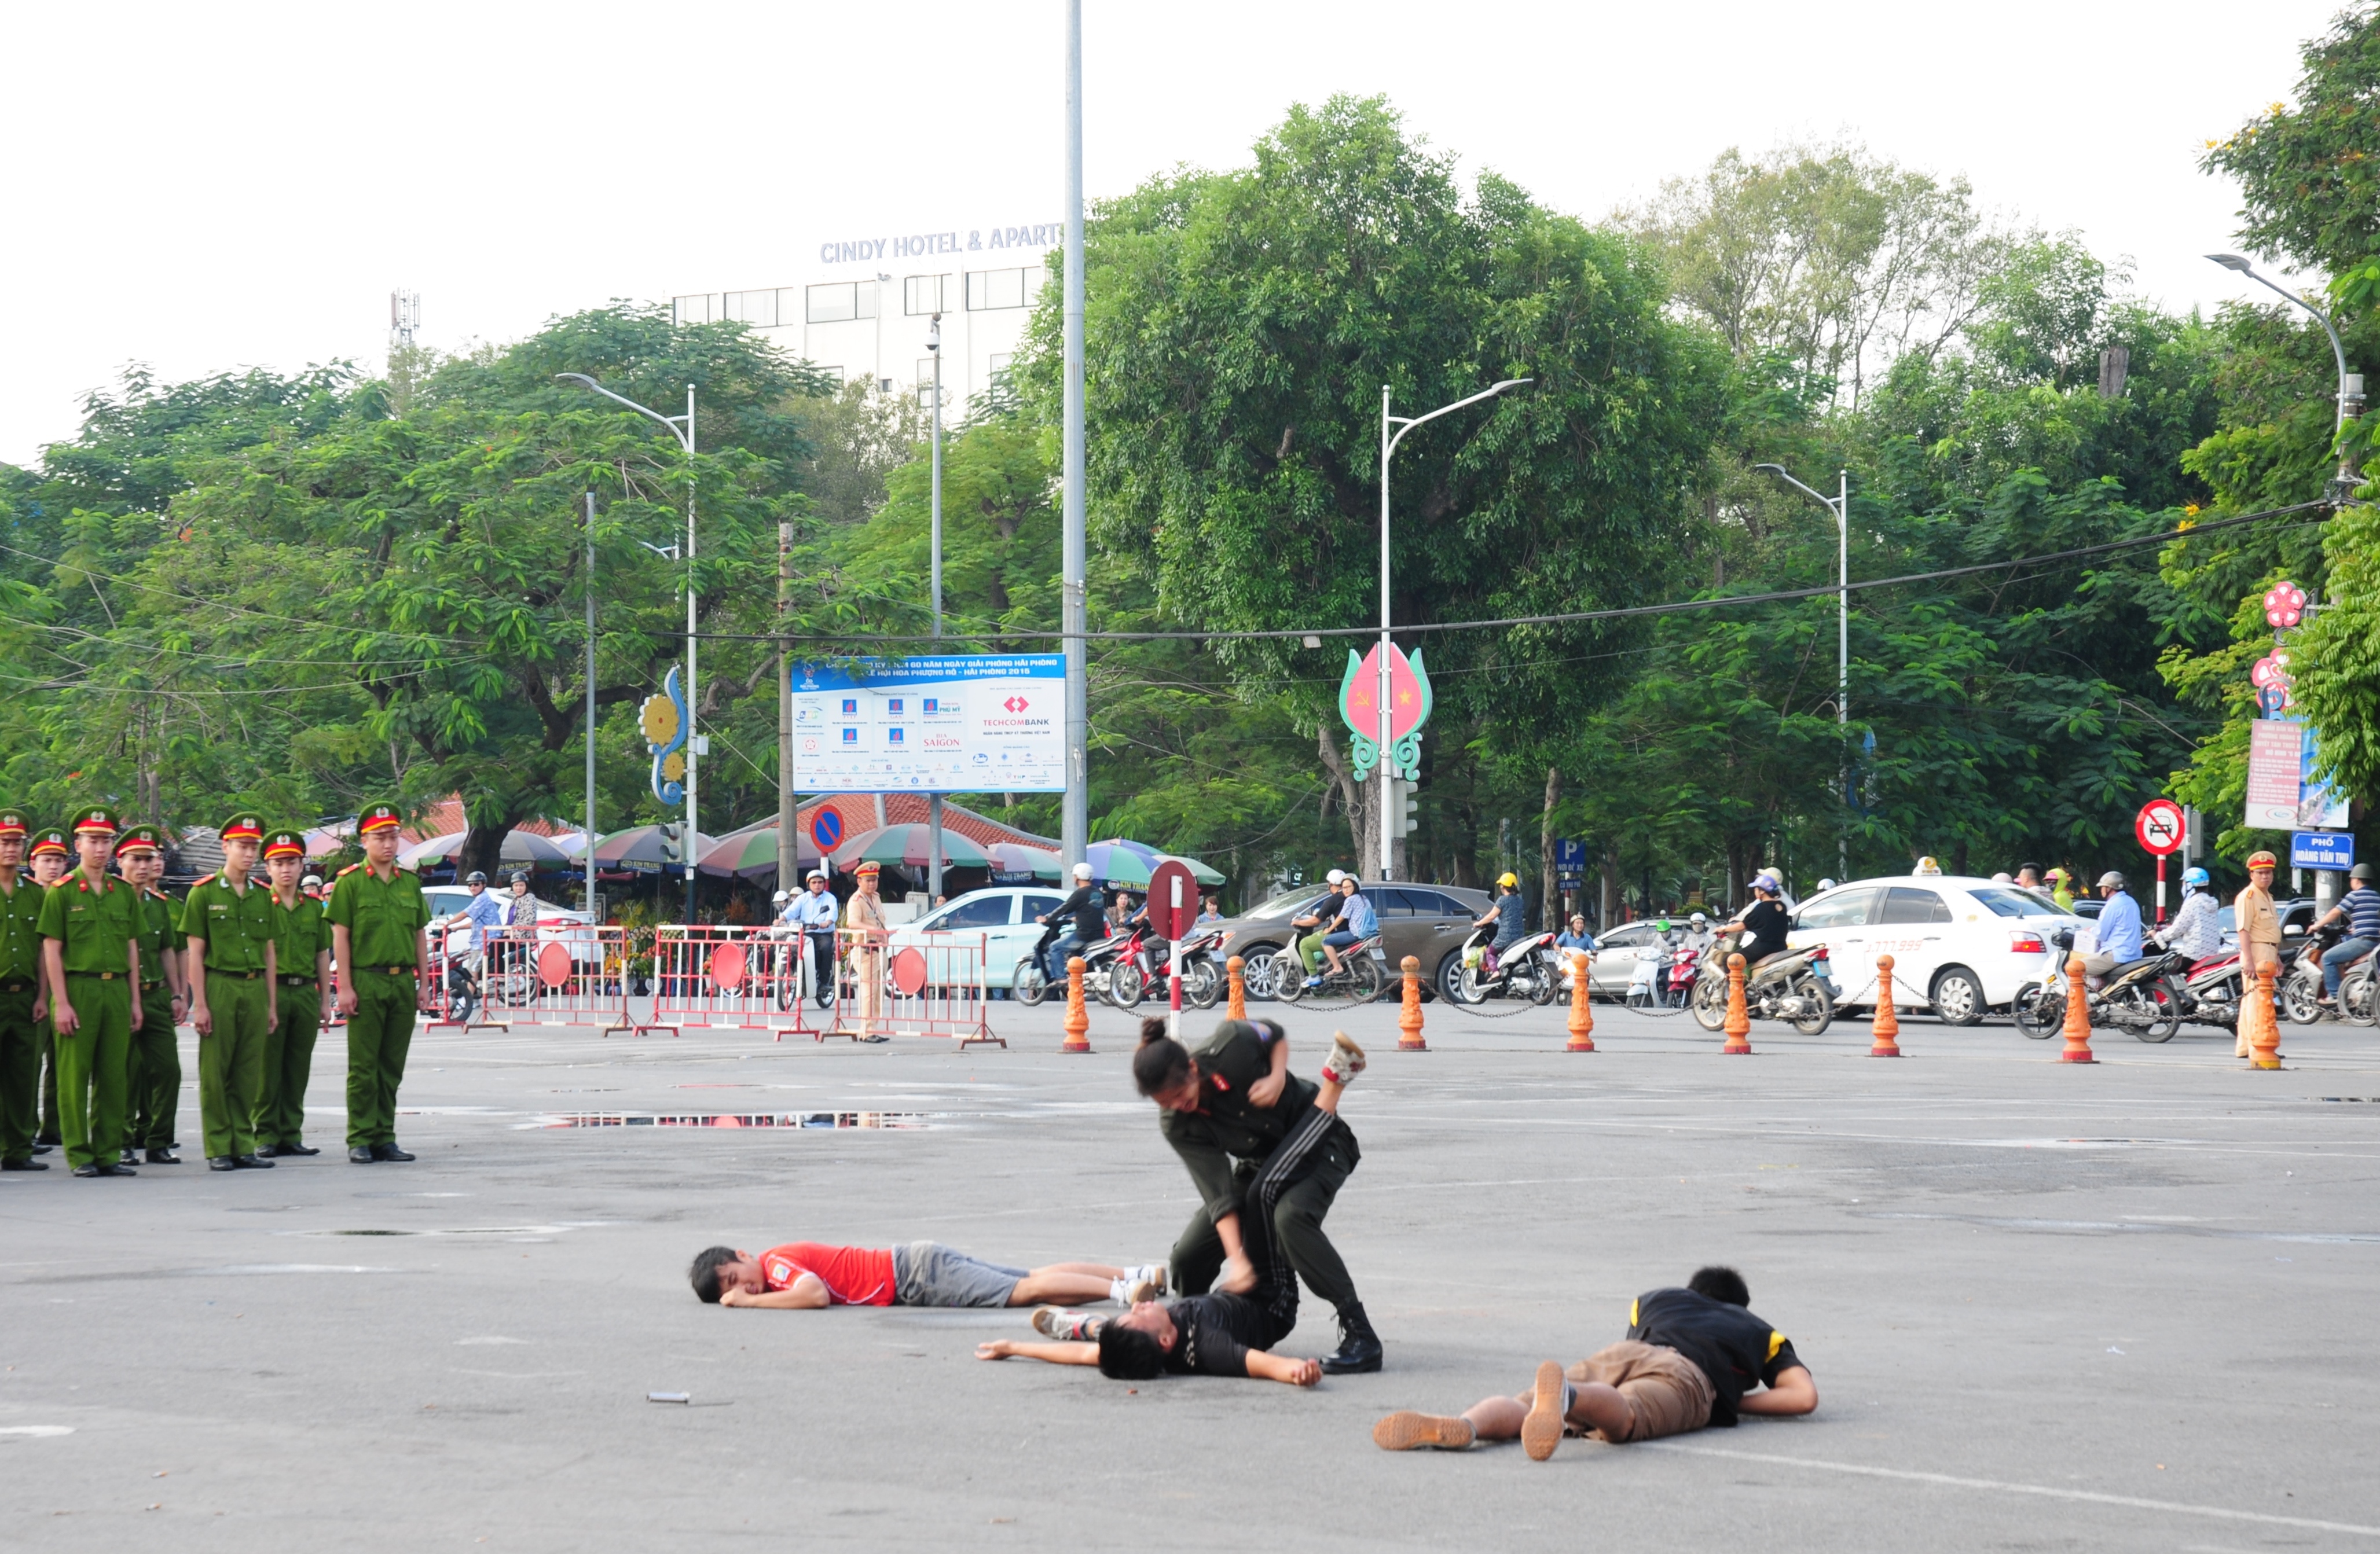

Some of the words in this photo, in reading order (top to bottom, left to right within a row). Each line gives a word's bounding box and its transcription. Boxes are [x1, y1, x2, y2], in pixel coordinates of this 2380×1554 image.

[820, 238, 887, 263] CINDY
[893, 232, 962, 258] HOTEL
[967, 230, 982, 251] &
[988, 222, 1064, 249] APART
[944, 660, 966, 668] NGÀY
[980, 667, 1007, 675] PHÒNG
[923, 739, 960, 747] SAIGON
[2311, 836, 2334, 847] PHỐ
[1565, 840, 1578, 859] P
[2295, 848, 2319, 862] HOÀNG
[2319, 849, 2334, 863] VĂN
[2335, 852, 2349, 866] THỤ
[1576, 864, 1584, 872] XE
[1120, 880, 1132, 888] KIM
